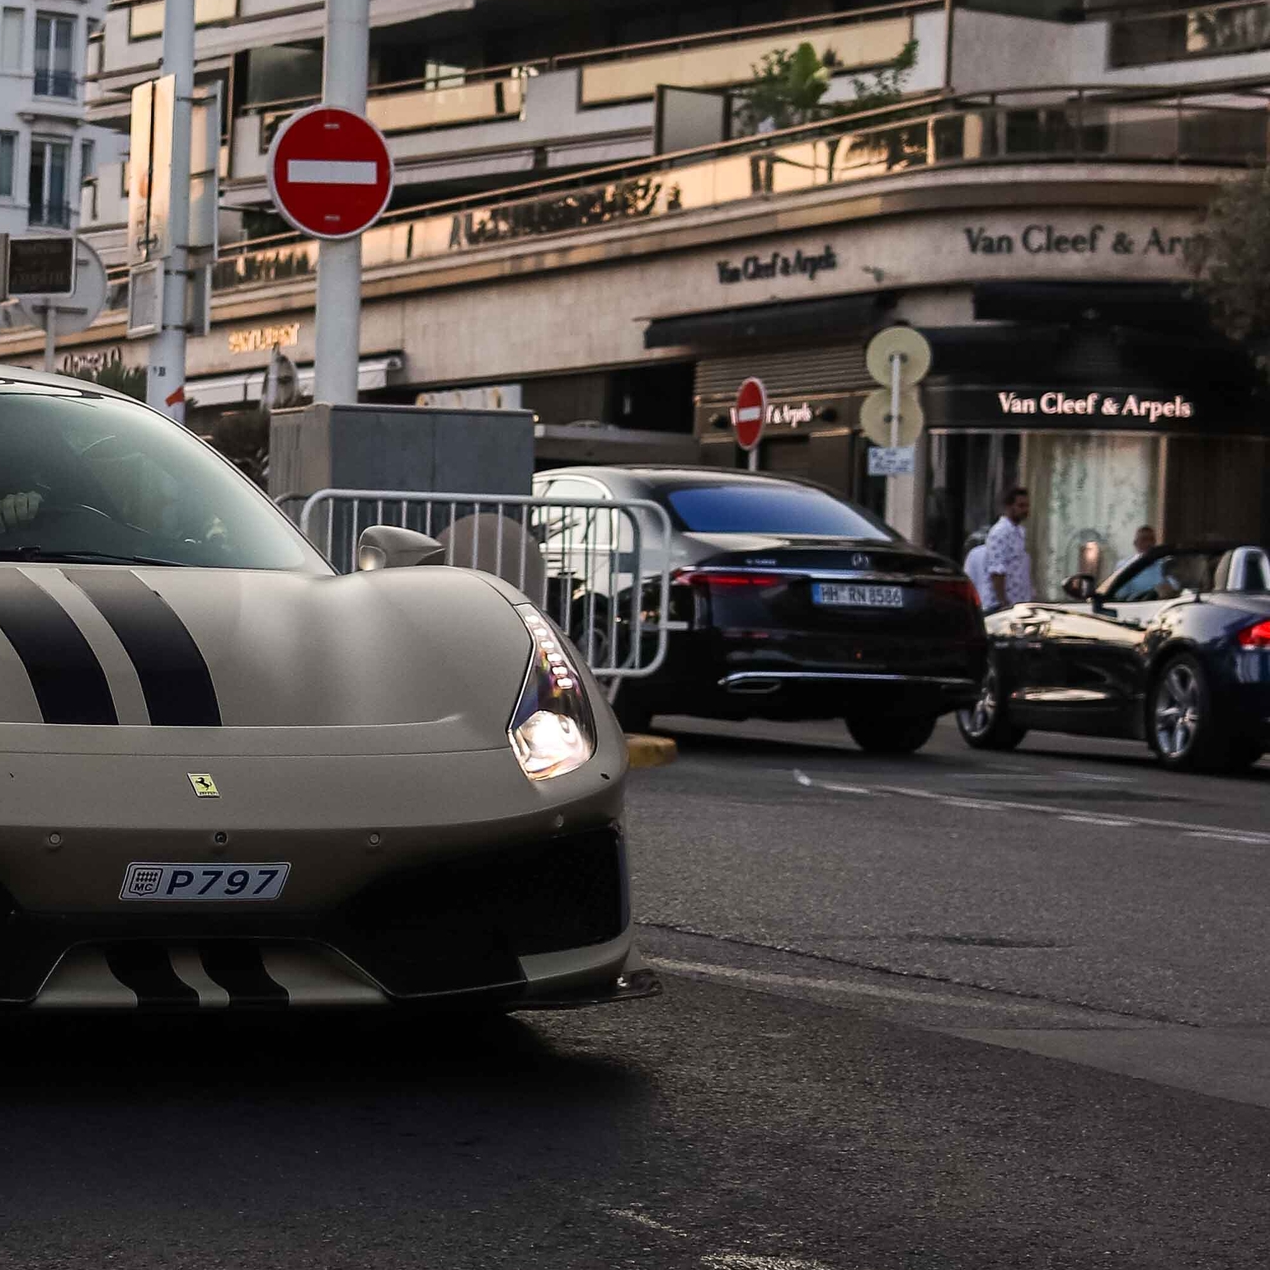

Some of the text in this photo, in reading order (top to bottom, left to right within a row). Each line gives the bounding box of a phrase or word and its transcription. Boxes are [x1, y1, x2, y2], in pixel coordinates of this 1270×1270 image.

[964, 228, 1013, 255] Van
[1022, 225, 1104, 254] Cleef
[1112, 231, 1134, 255] &
[998, 391, 1193, 423] Van Cleef & Arpels
[134, 883, 153, 892] MC
[166, 870, 279, 895] P797
